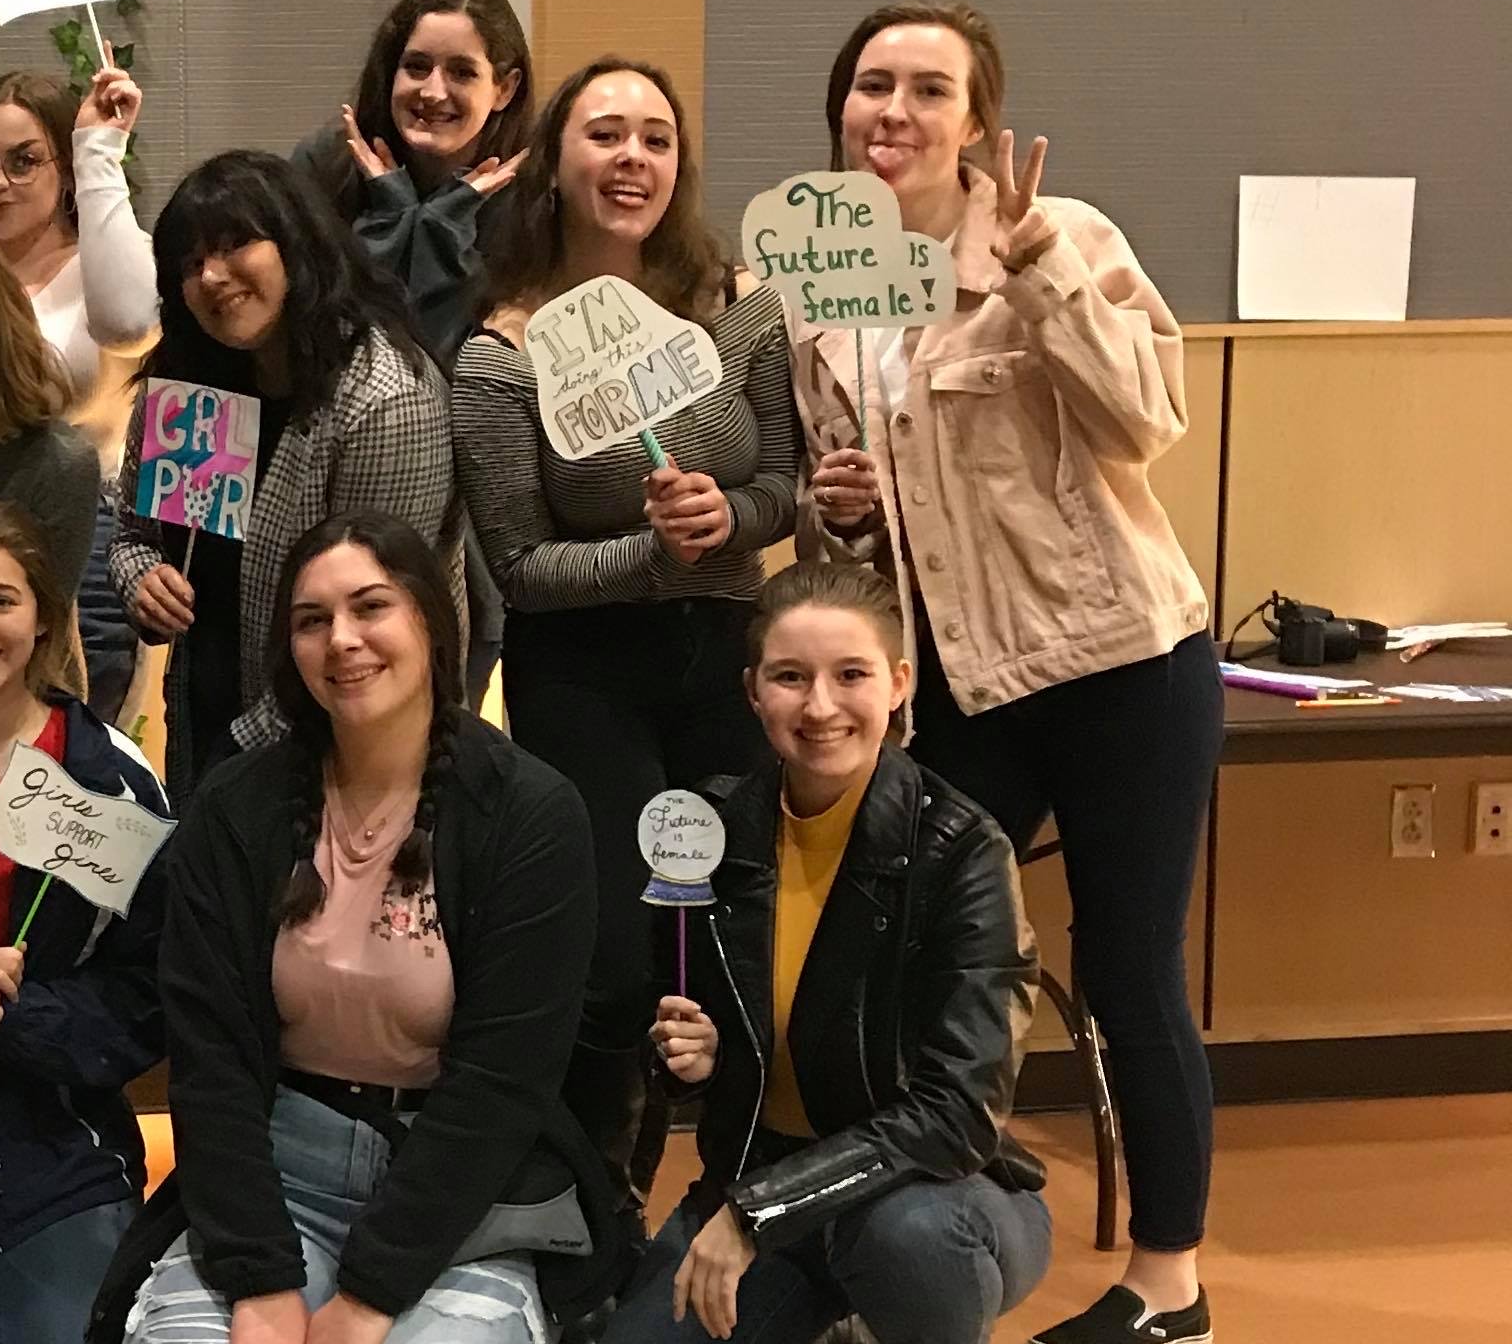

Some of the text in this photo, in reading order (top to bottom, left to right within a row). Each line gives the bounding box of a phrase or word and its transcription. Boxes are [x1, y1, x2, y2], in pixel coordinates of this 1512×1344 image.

[787, 182, 874, 229] The
[755, 229, 879, 281] future
[801, 280, 937, 324] female!
[526, 281, 641, 376] I'M
[553, 332, 653, 399] doing this
[554, 329, 715, 455] FOR ME
[150, 458, 250, 543] PWR
[45, 811, 110, 850] SUPPORT
[648, 805, 712, 833] Future
[650, 842, 712, 867] female
